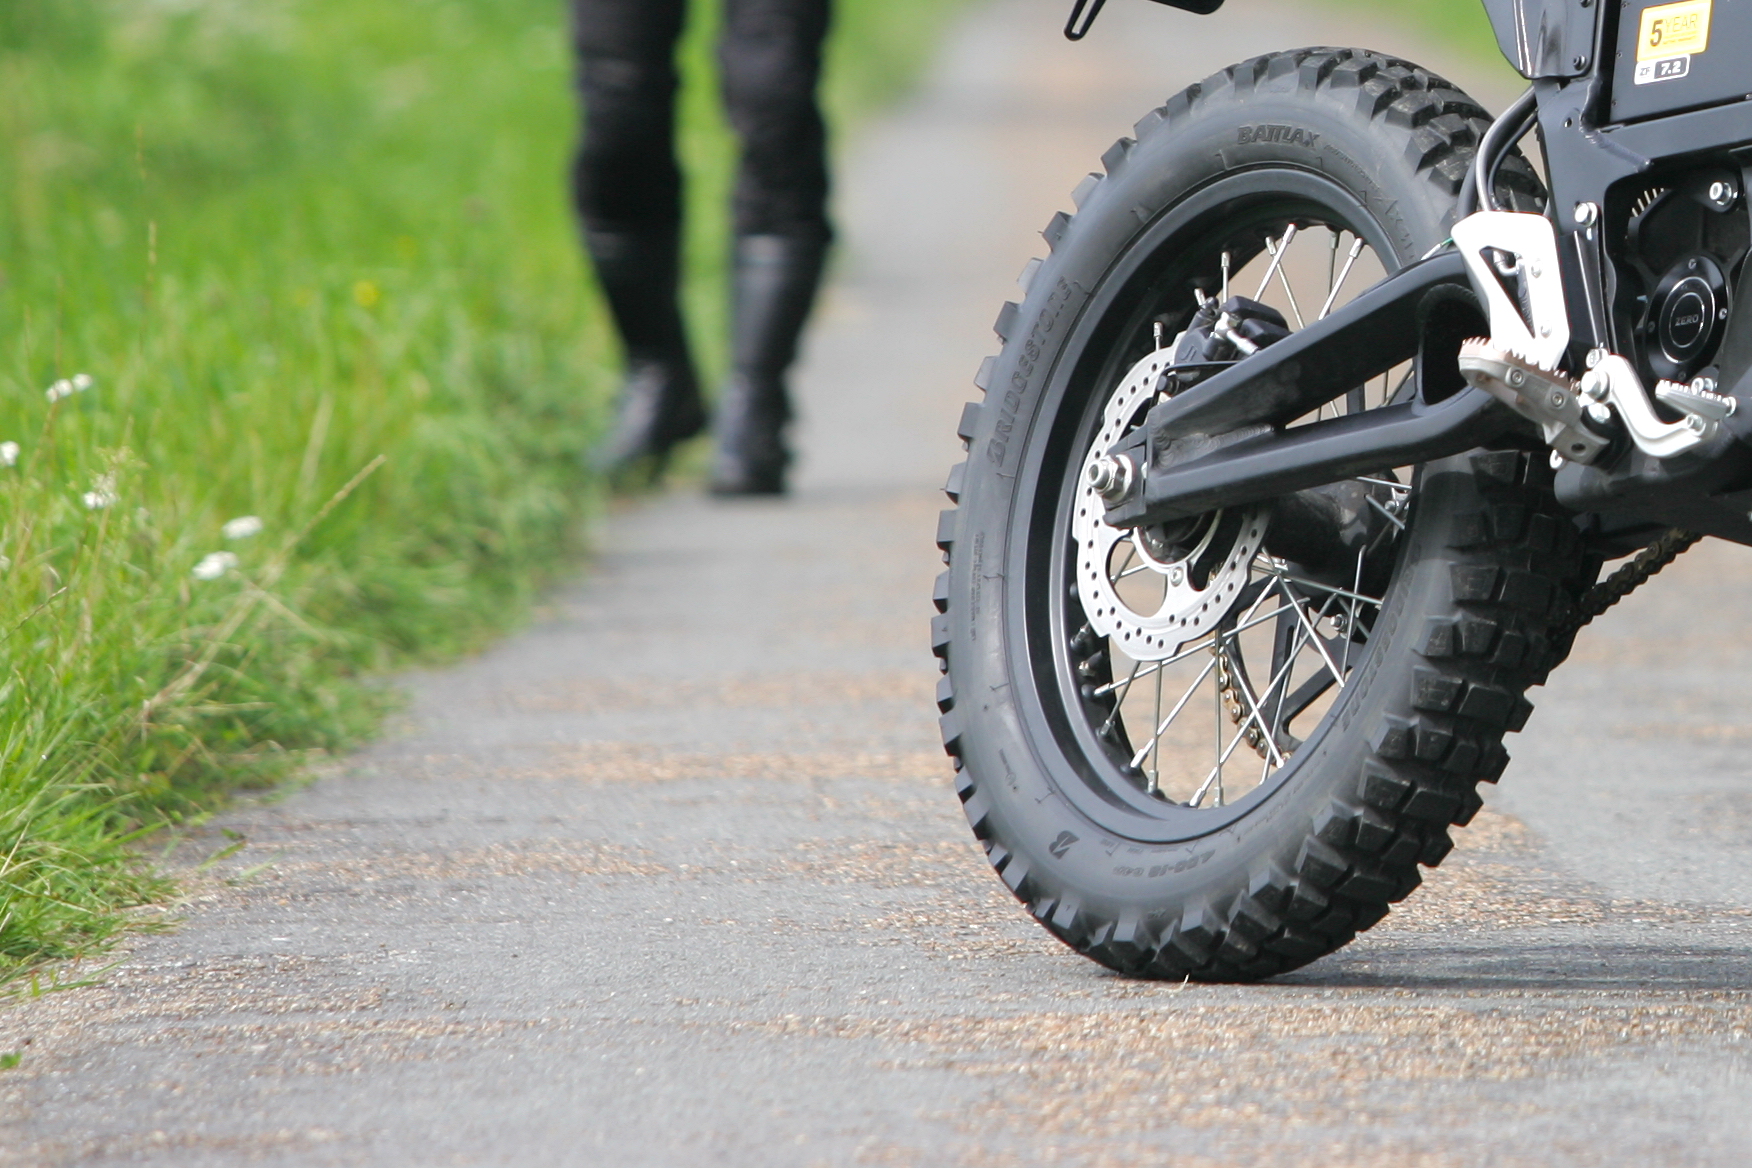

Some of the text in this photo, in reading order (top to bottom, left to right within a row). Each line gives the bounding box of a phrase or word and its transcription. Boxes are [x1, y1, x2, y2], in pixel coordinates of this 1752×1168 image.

[1650, 19, 1663, 47] 5
[1664, 13, 1698, 33] YEAR
[1660, 60, 1682, 76] 7.2
[1675, 314, 1699, 327] ZERO
[987, 275, 1072, 468] BRIDGESTONE
